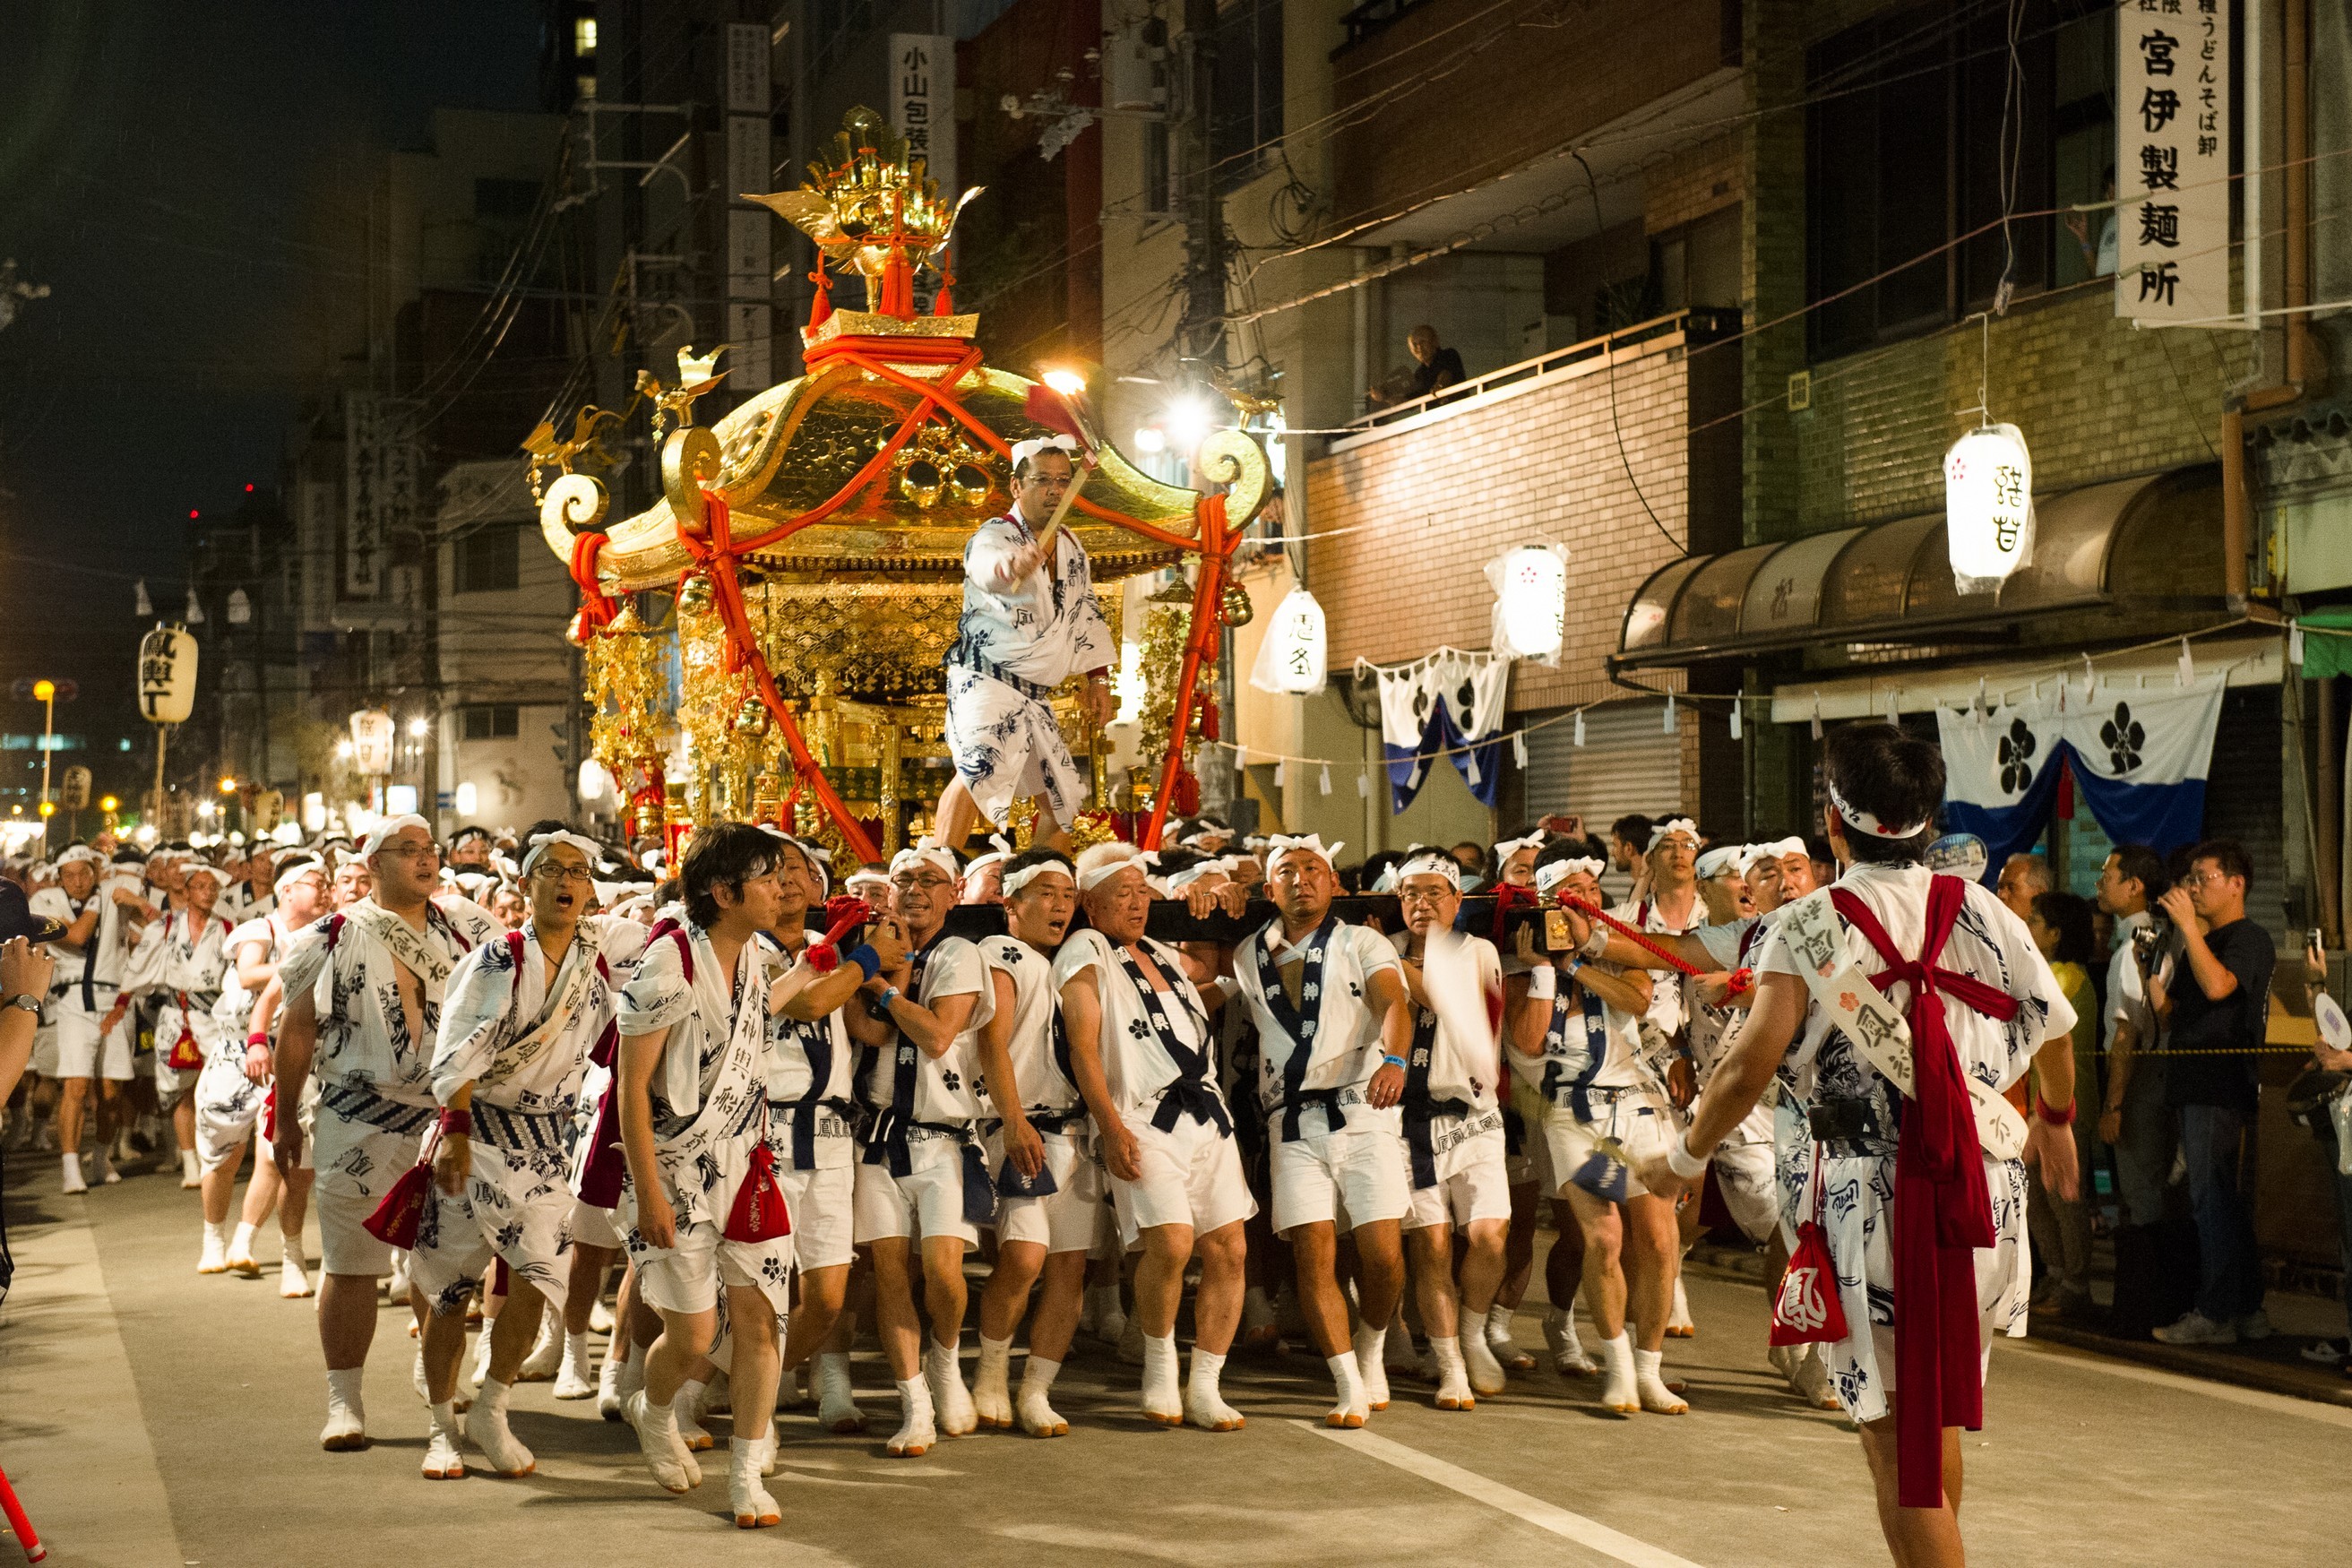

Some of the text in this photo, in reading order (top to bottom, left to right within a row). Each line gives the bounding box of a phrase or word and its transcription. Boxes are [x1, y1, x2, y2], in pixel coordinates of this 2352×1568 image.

[2138, 29, 2182, 307] 宮伊製麺所
